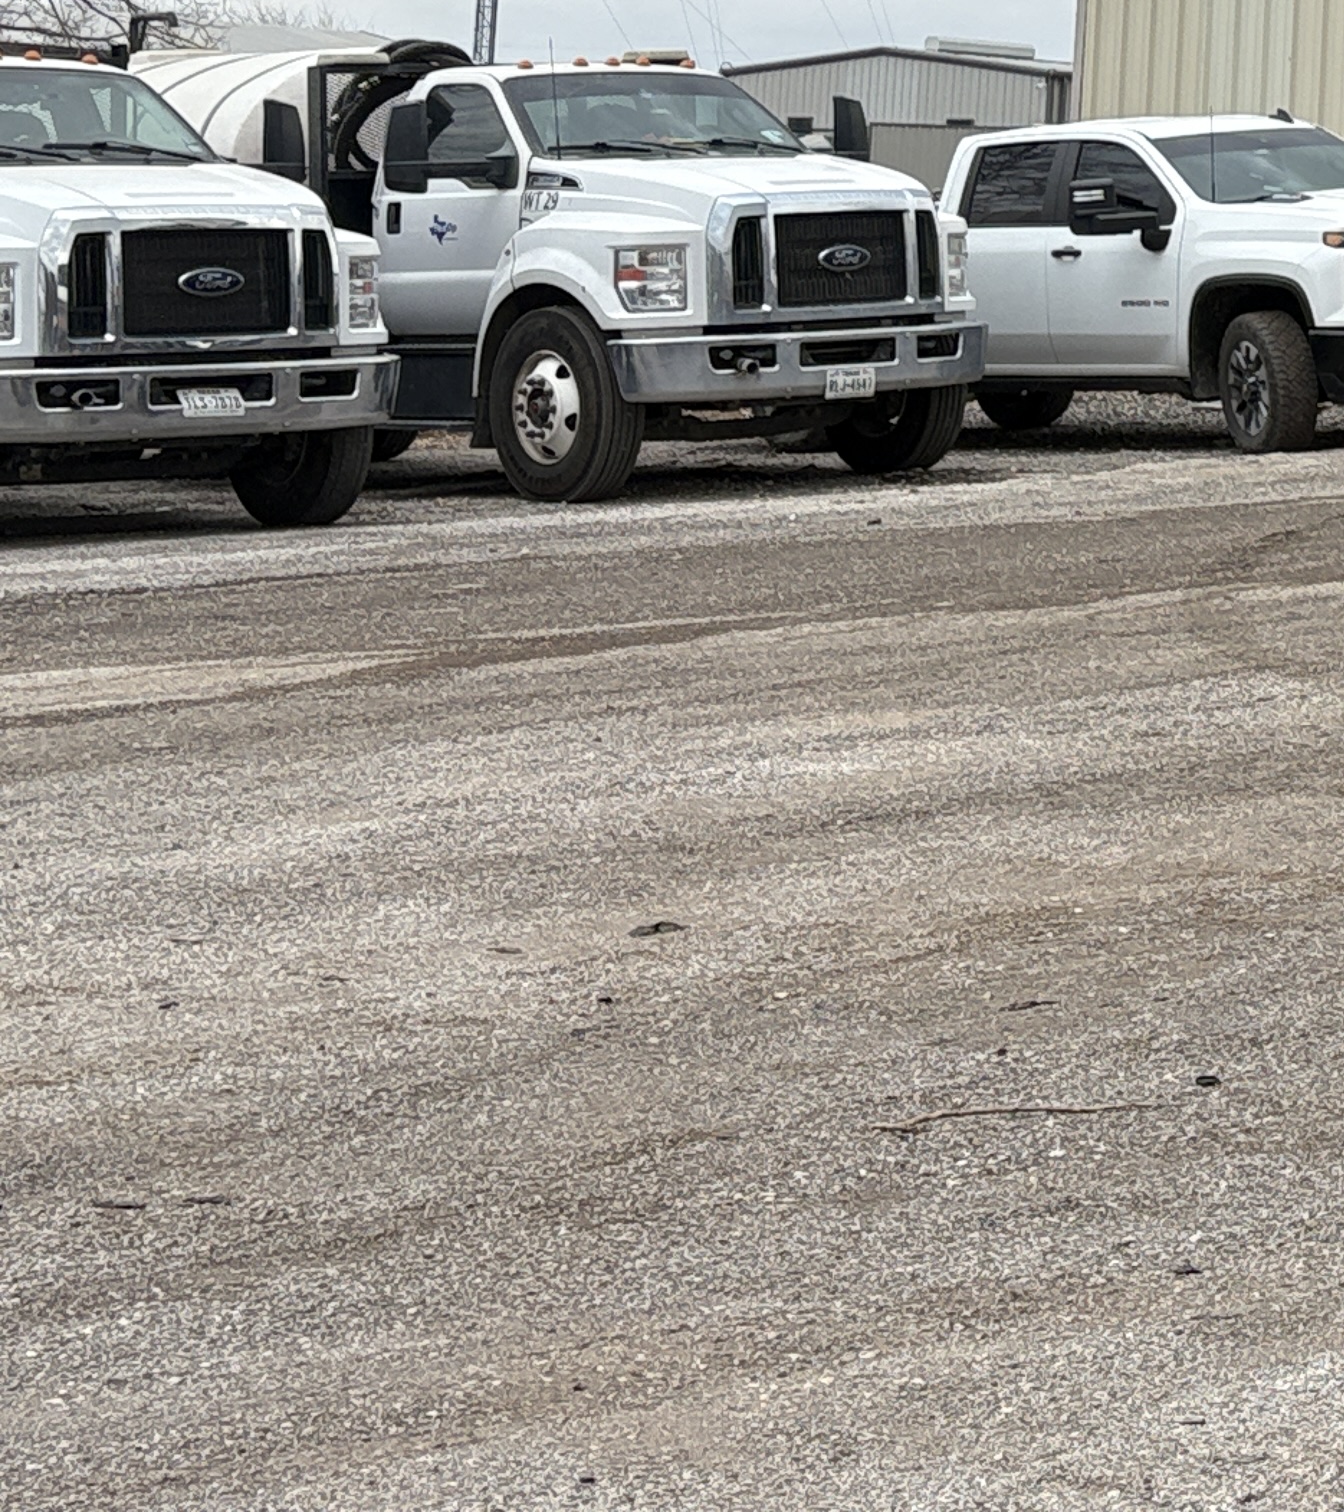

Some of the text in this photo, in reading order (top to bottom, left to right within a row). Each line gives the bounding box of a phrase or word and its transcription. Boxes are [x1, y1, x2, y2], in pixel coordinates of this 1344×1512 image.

[523, 191, 559, 210] WT 29
[195, 272, 232, 289] Ford
